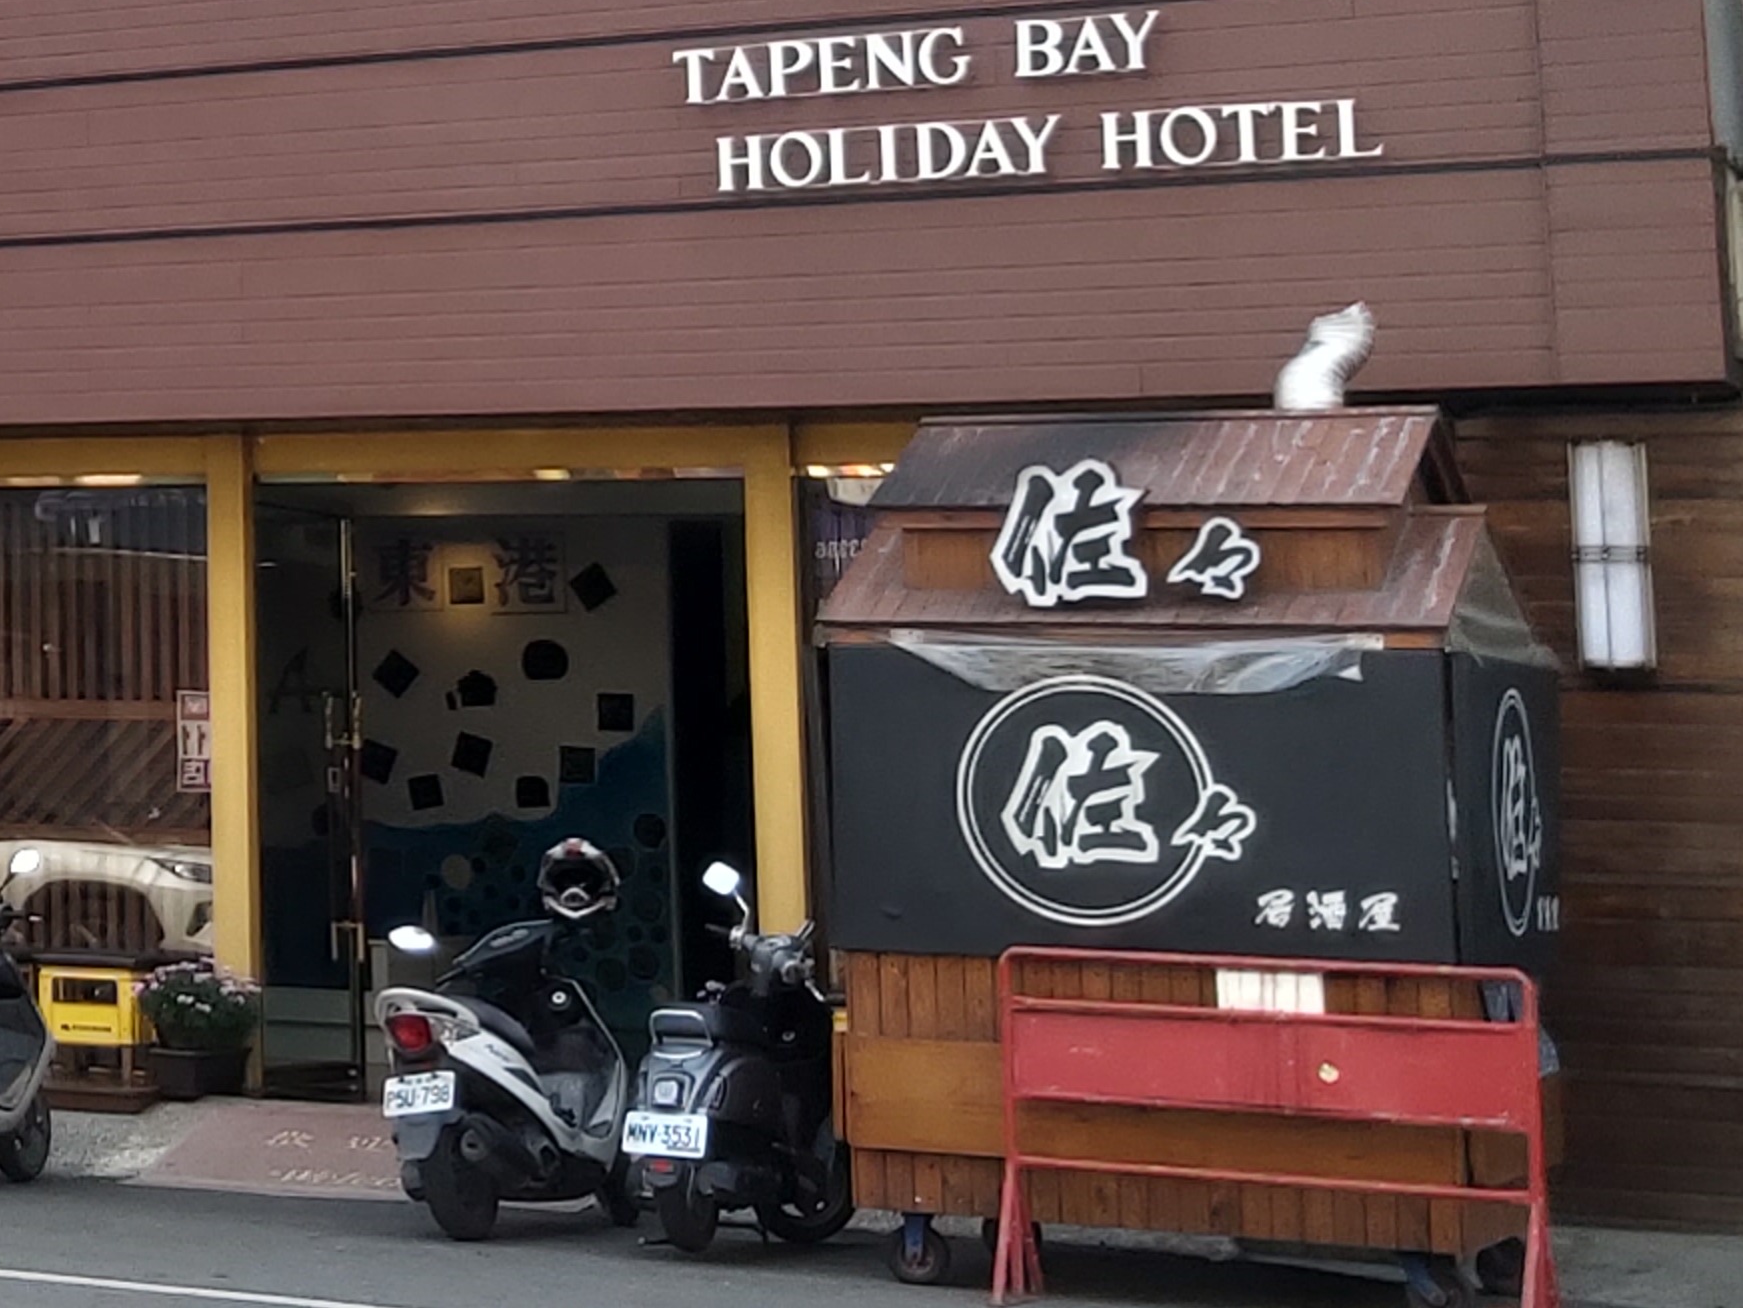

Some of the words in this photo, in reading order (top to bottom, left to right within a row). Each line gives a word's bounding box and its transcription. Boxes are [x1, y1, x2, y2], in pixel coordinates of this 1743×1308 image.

[672, 26, 972, 106] TAPENG
[1014, 11, 1160, 79] BAY
[715, 114, 1060, 193] HOLIDAY
[1099, 98, 1384, 171] HOTEL
[1254, 888, 1402, 932] 居酒屋
